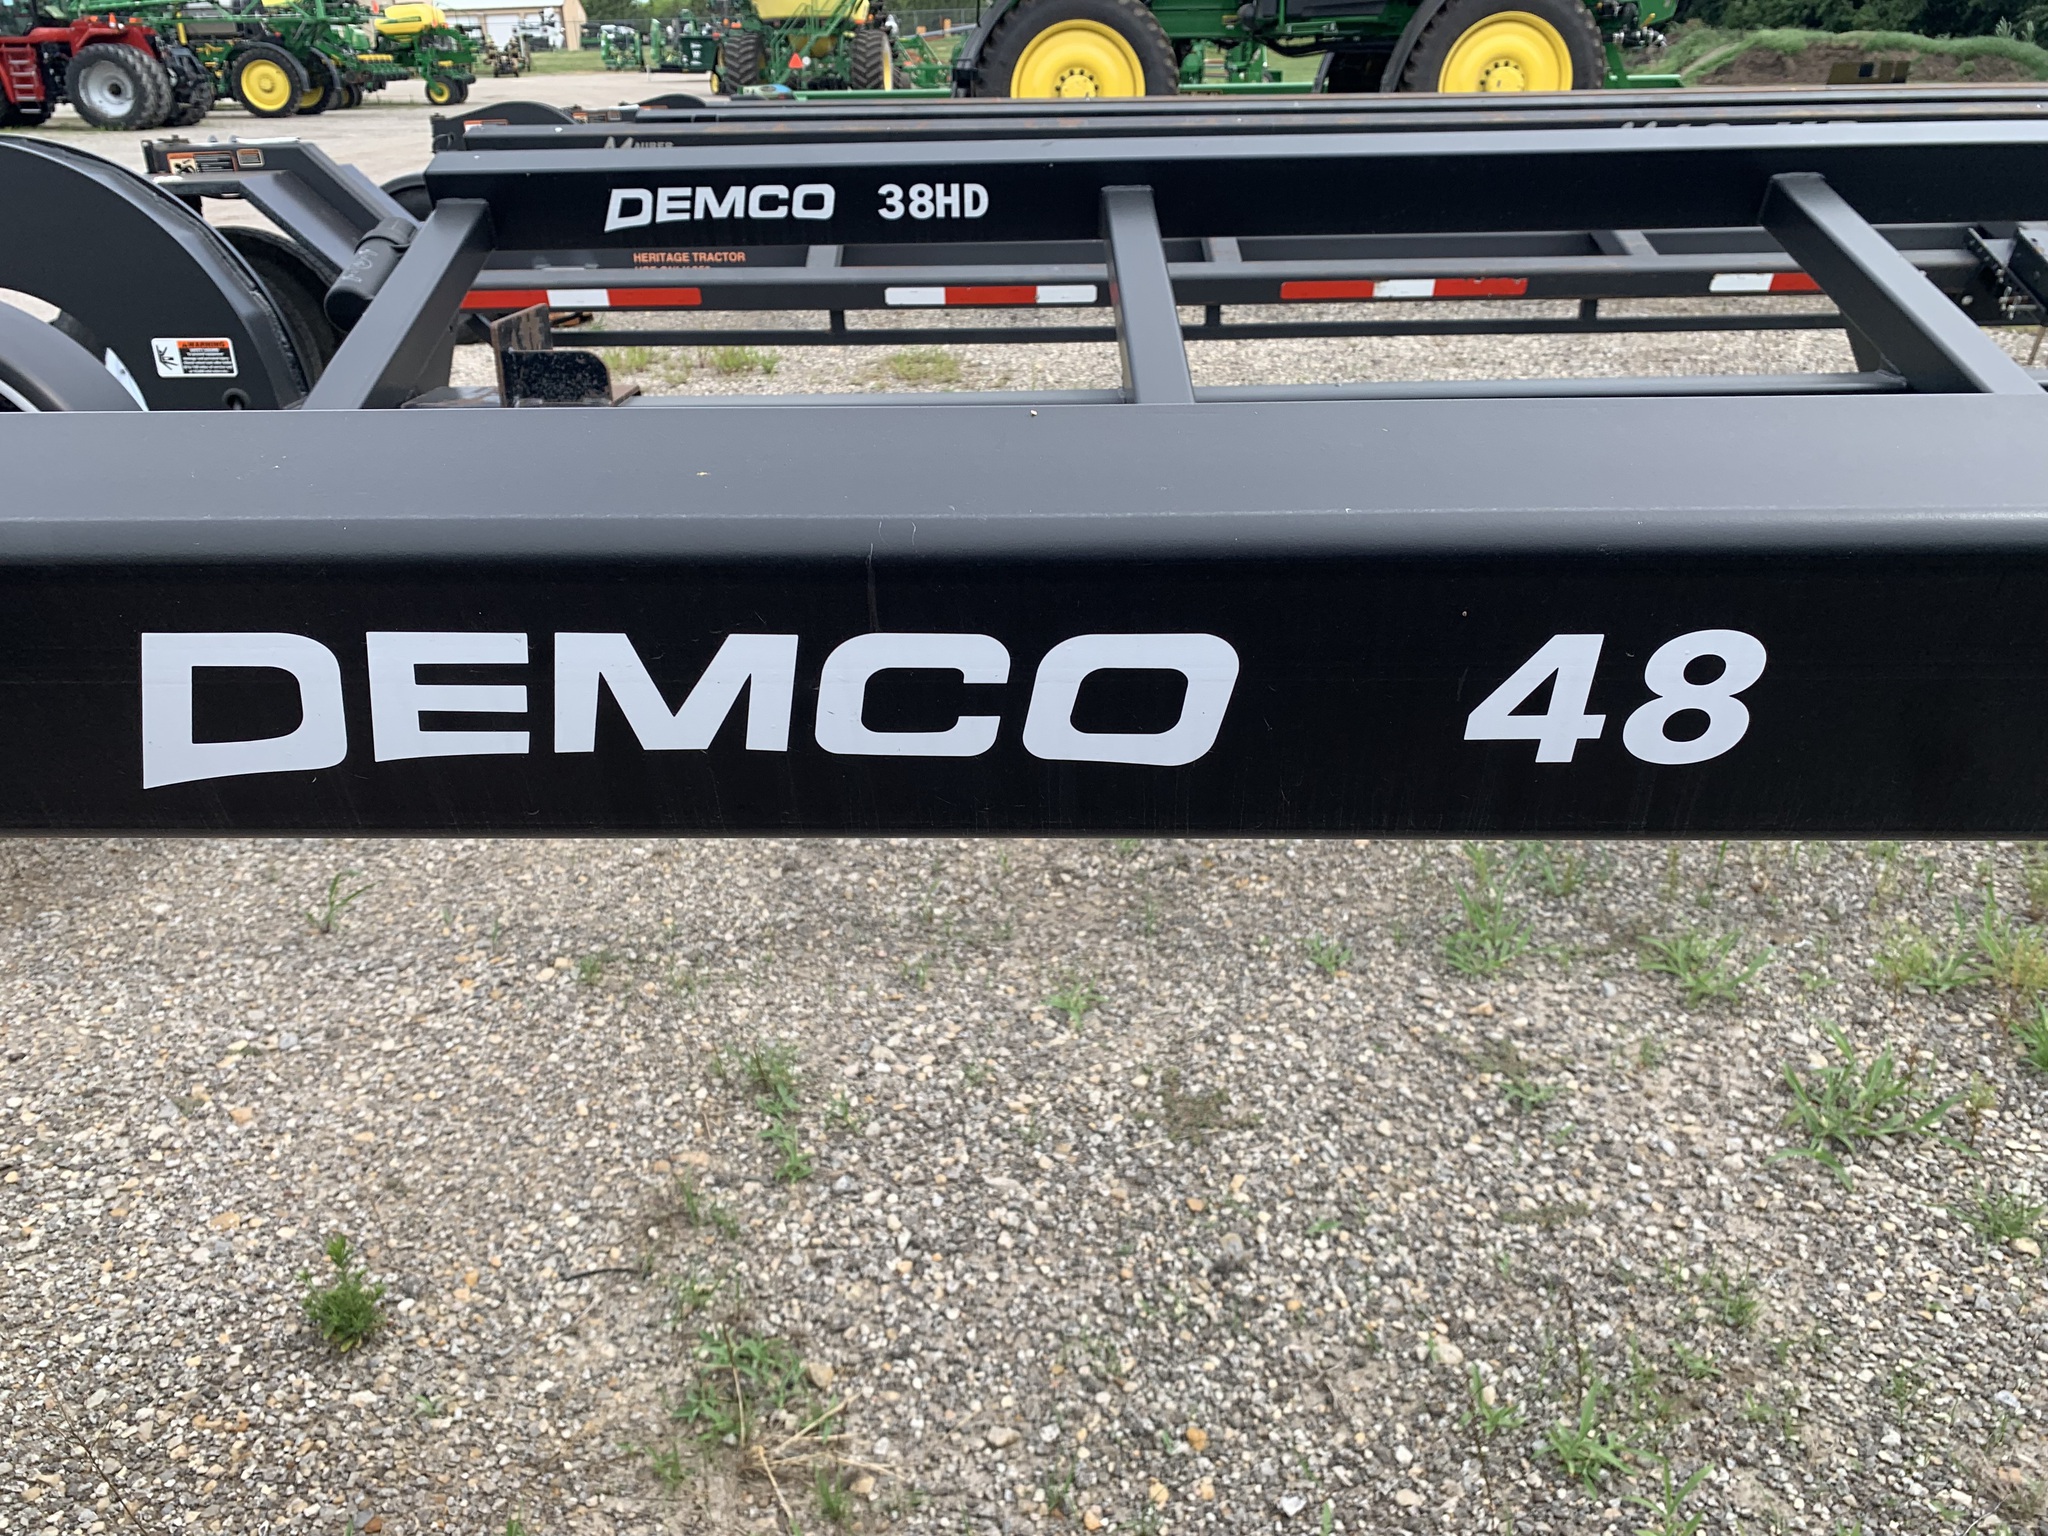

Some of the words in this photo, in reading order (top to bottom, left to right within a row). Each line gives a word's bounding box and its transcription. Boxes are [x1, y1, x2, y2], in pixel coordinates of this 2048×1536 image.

[604, 183, 836, 232] DEMCO
[877, 183, 989, 220] 38HD
[633, 252, 690, 262] HERITAGE
[692, 251, 746, 262] TRACTOR
[141, 631, 1240, 790] DEMCO
[1463, 629, 1767, 765] 48
